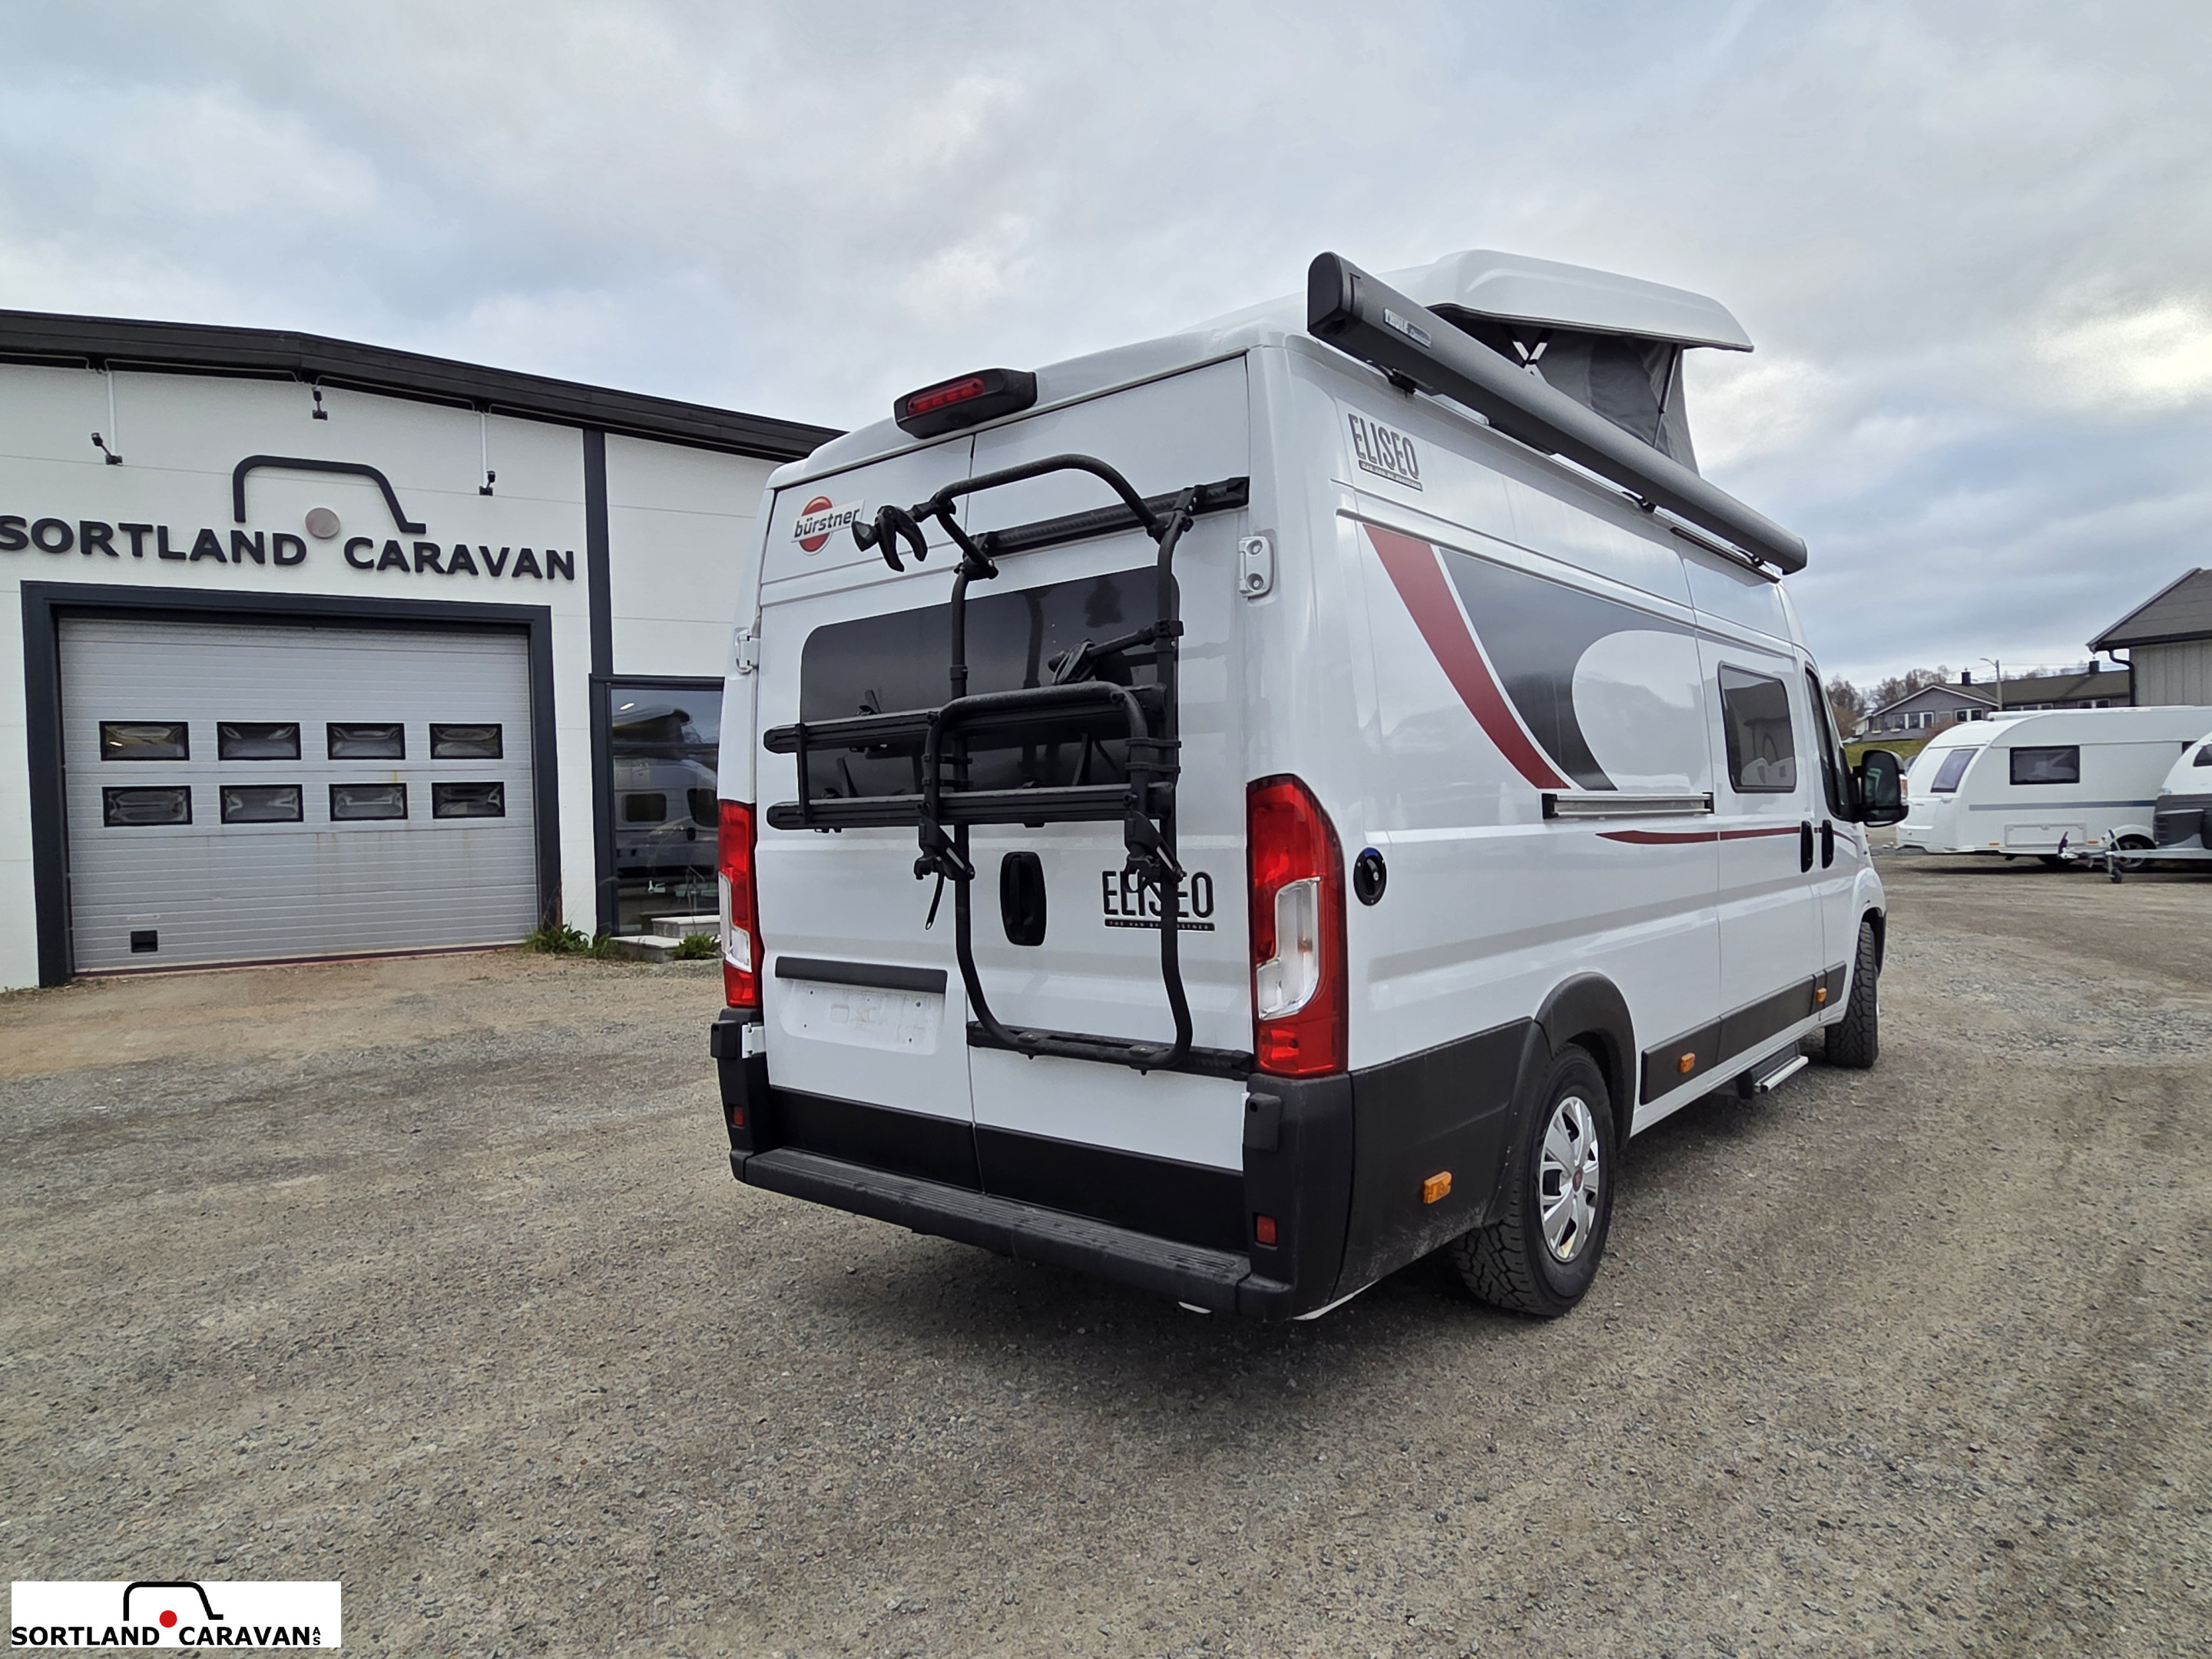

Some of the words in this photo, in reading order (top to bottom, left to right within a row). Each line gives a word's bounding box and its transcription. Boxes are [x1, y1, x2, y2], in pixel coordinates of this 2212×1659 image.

[1348, 412, 1419, 480] ELISEO
[0, 515, 307, 566] SORTLAND
[343, 537, 575, 581] CARAVAN
[794, 508, 860, 538] bürstner
